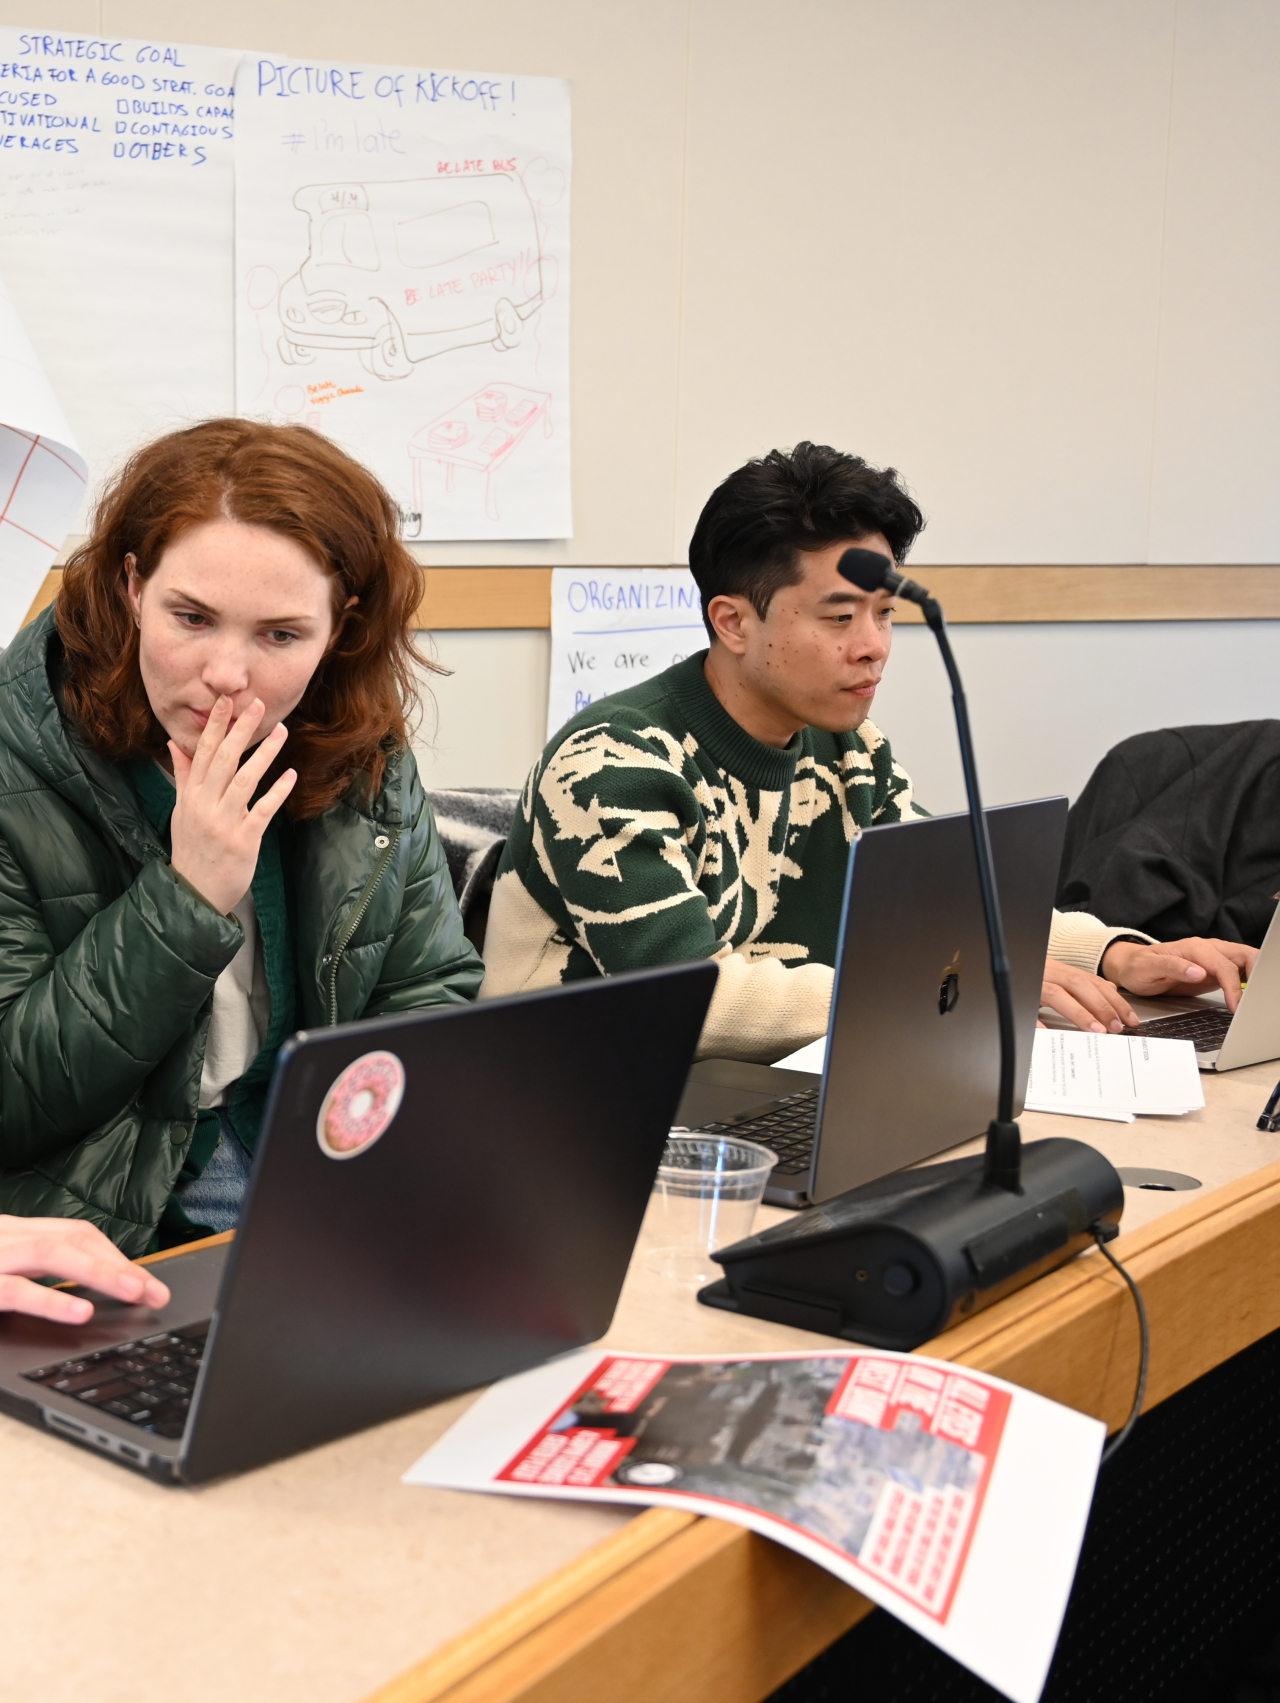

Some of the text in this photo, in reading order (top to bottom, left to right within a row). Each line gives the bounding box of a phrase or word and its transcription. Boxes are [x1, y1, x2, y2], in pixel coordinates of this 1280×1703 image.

[19, 35, 187, 67] STRATEGIC GOAL
[48, 68, 79, 83] FOR
[86, 68, 97, 83] A
[101, 71, 146, 90] GOOD
[204, 84, 235, 98] GOA
[258, 60, 366, 99] PICTURE
[375, 74, 406, 107] OF
[132, 100, 189, 117] BUILDS
[130, 121, 234, 140] CONTAGIOUS
[455, 160, 484, 173] LATE
[492, 158, 518, 172] BUS
[404, 287, 421, 306] BE
[429, 279, 464, 299] LATE
[568, 650, 597, 674] We
[614, 652, 651, 670] are
